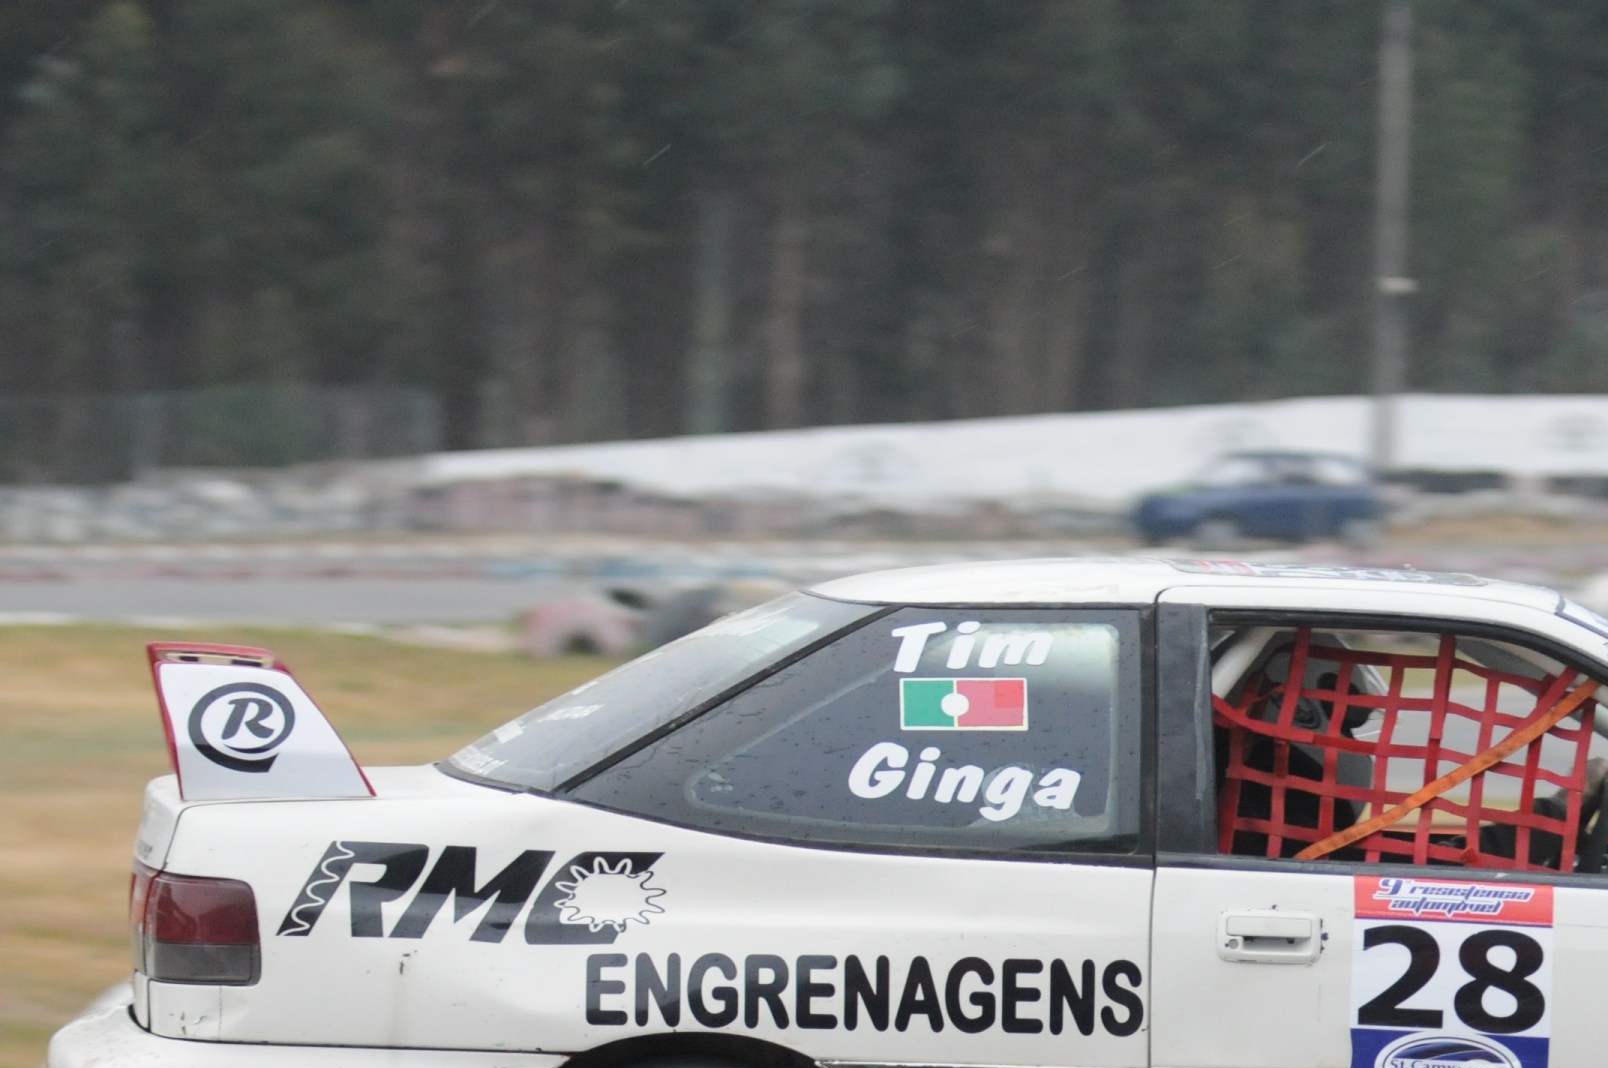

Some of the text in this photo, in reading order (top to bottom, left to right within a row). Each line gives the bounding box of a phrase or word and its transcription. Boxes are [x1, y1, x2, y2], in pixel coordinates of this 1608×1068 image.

[892, 621, 1053, 673] Tim
[848, 742, 1082, 822] Ginga
[276, 840, 667, 945] RMC
[586, 952, 1145, 1037] ENGRENAGENS
[1357, 924, 1546, 1034] 28
